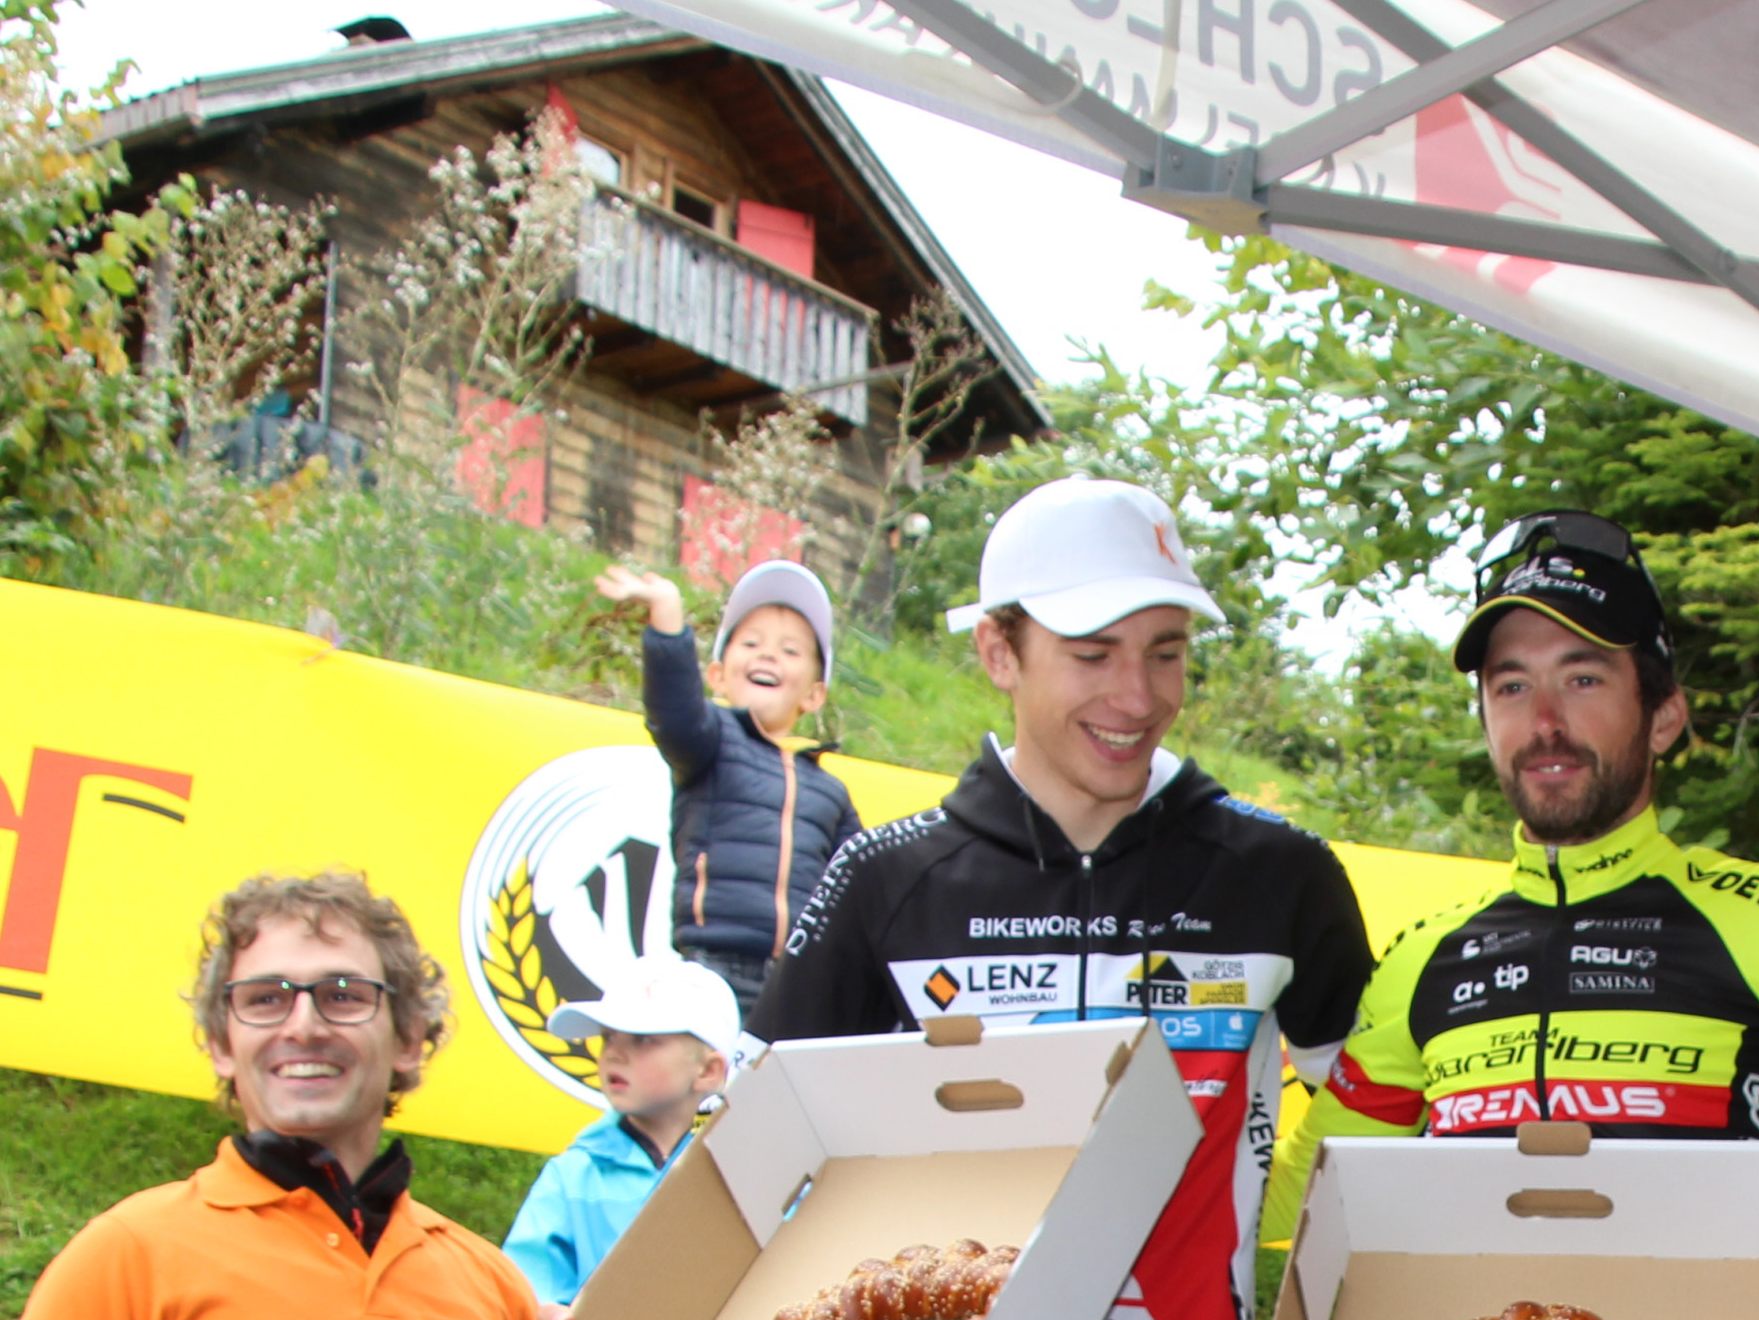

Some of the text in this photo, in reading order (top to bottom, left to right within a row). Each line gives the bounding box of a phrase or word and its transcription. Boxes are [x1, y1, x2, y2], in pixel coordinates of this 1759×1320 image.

[969, 915, 1118, 938] BIKEWORKS
[1570, 945, 1633, 964] AGU
[967, 962, 1058, 993] LENZ
[1494, 963, 1529, 990] tip
[1573, 974, 1650, 990] SAMINA
[989, 993, 1057, 1005] WOHNBAU
[1126, 982, 1187, 1005] PTER
[1490, 1027, 1559, 1048] TEAM
